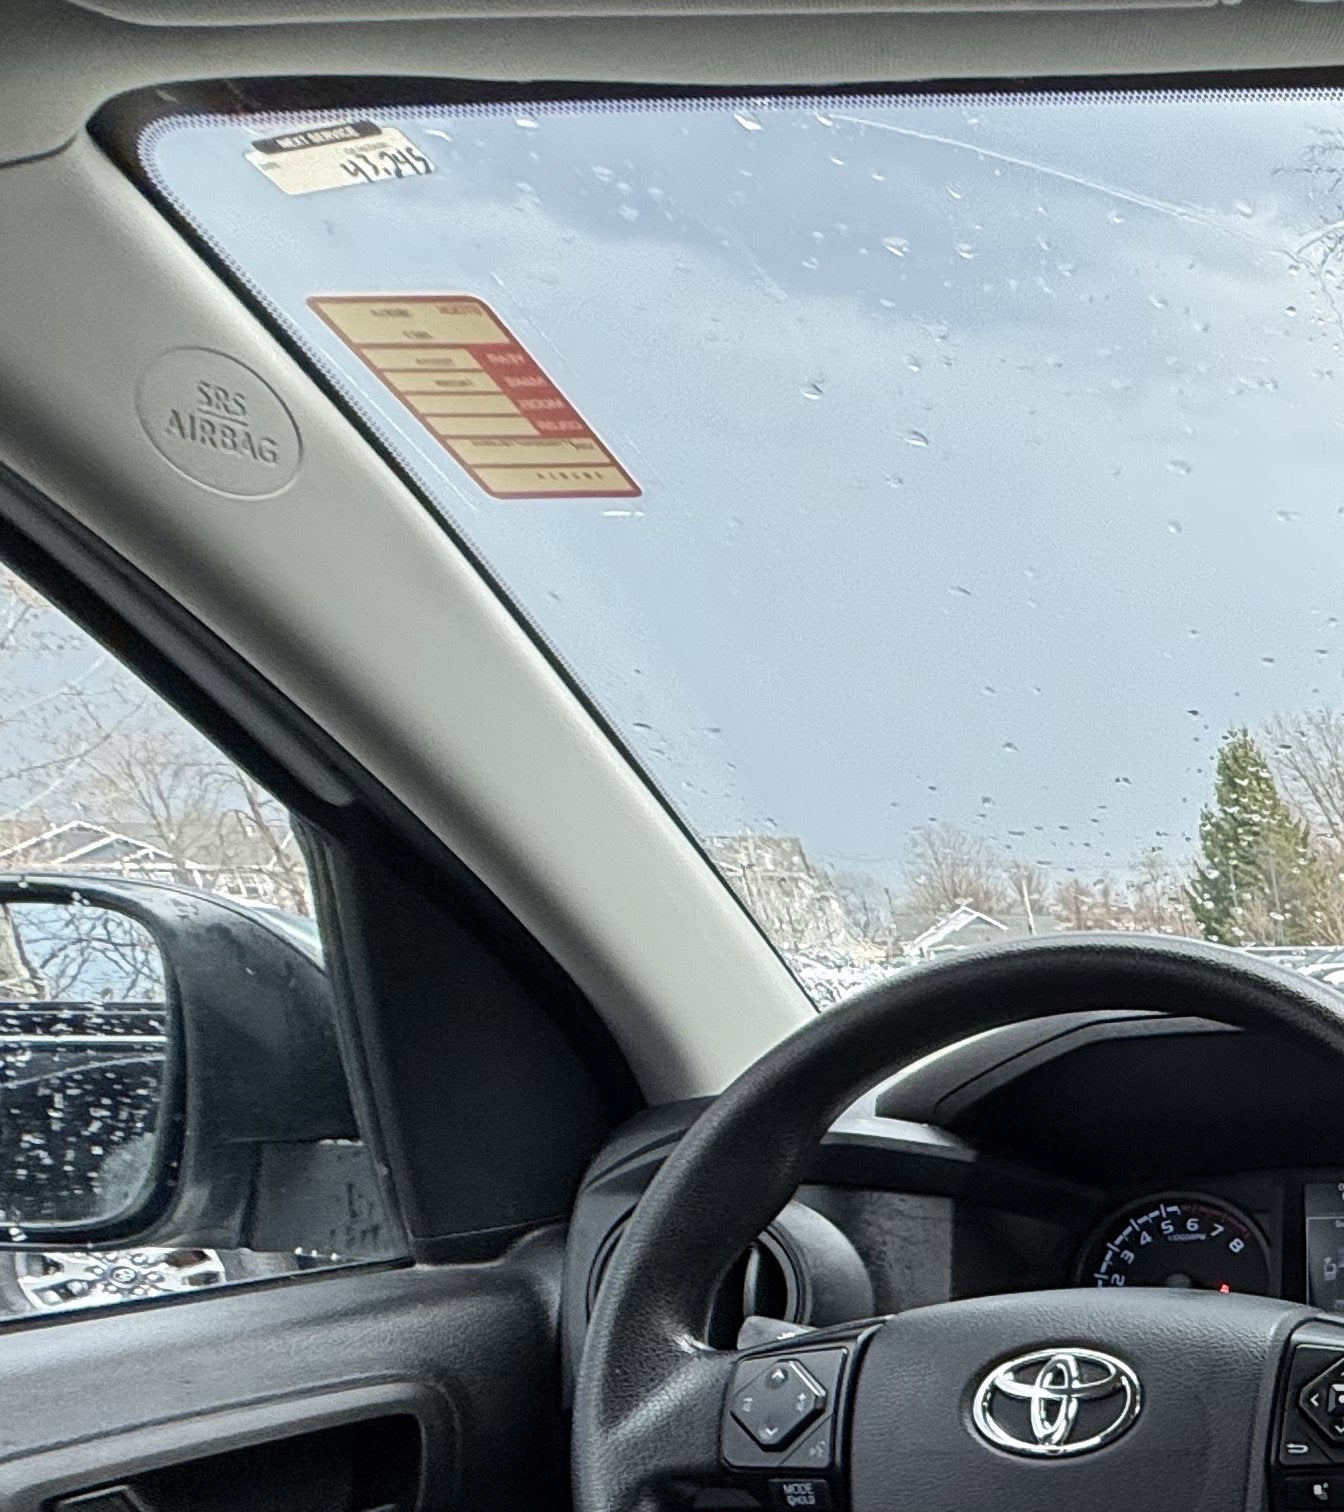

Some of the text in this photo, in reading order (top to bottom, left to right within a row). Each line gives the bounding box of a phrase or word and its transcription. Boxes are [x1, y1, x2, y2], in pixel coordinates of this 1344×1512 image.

[197, 380, 246, 416] SRS
[165, 408, 279, 464] AIRBAG
[1160, 1220, 1174, 1234] 5
[1186, 1218, 1199, 1231] 6
[1210, 1223, 1224, 1237] 7
[1140, 1230, 1153, 1245] 4
[1228, 1238, 1245, 1254] 8
[1120, 1250, 1135, 1264] 3
[1111, 1273, 1126, 1286] 2
[783, 1483, 813, 1495] MODE
